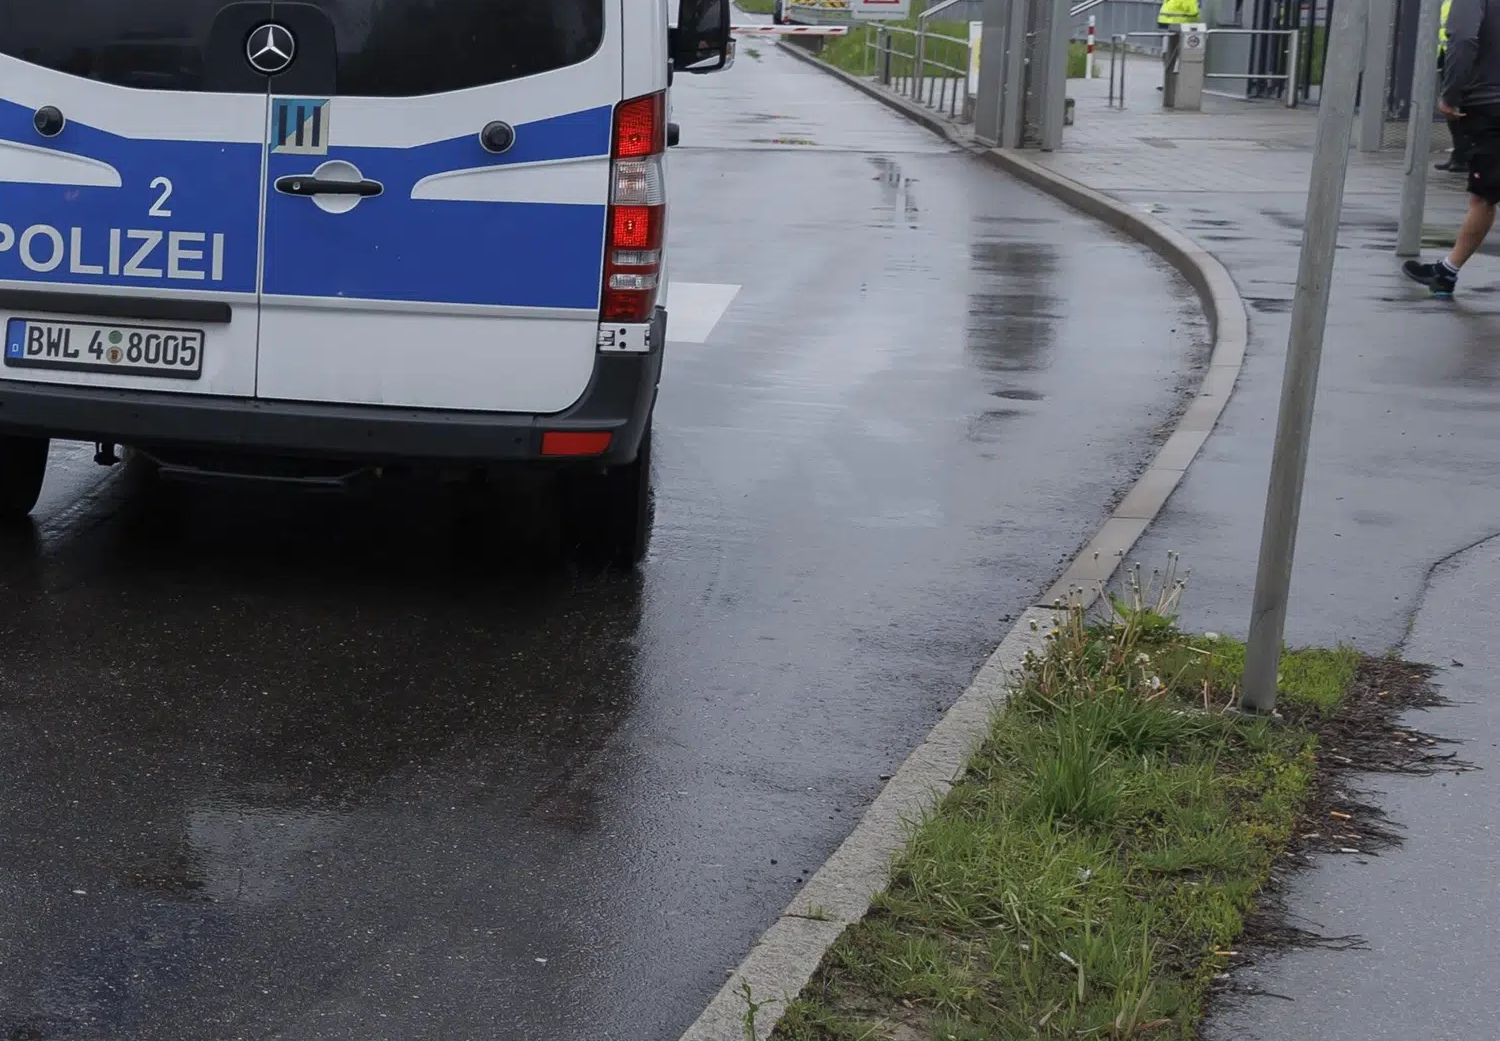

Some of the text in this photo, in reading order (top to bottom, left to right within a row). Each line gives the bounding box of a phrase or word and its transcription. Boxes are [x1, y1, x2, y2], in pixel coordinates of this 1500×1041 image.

[148, 176, 173, 217] 2
[26, 325, 198, 367] BWL 4 8005
